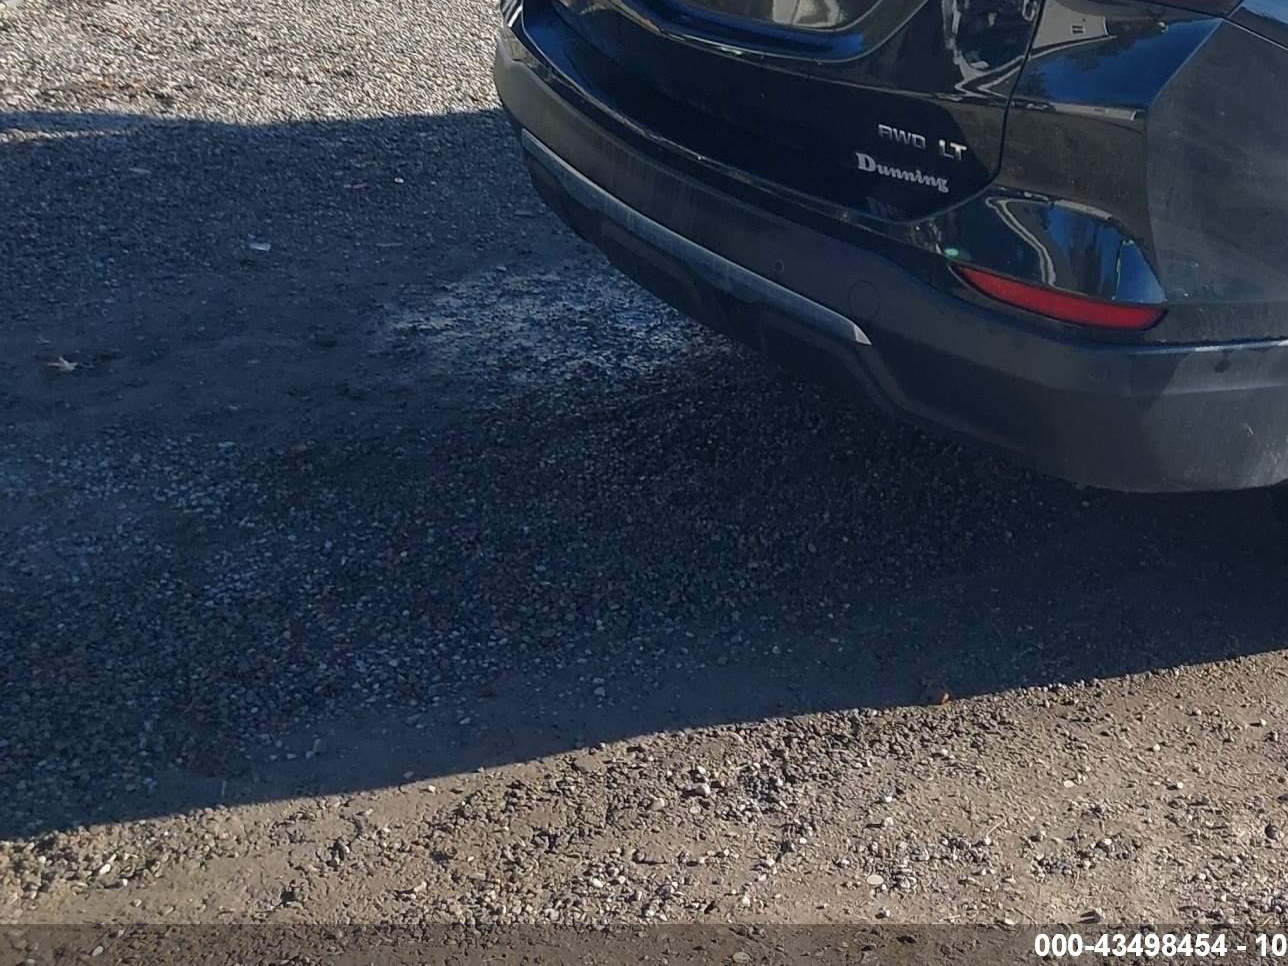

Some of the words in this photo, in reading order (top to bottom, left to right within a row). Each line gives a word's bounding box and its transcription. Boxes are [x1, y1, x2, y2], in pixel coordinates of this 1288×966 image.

[877, 123, 926, 150] AWD
[938, 138, 968, 162] LT
[855, 152, 950, 193] Dunning
